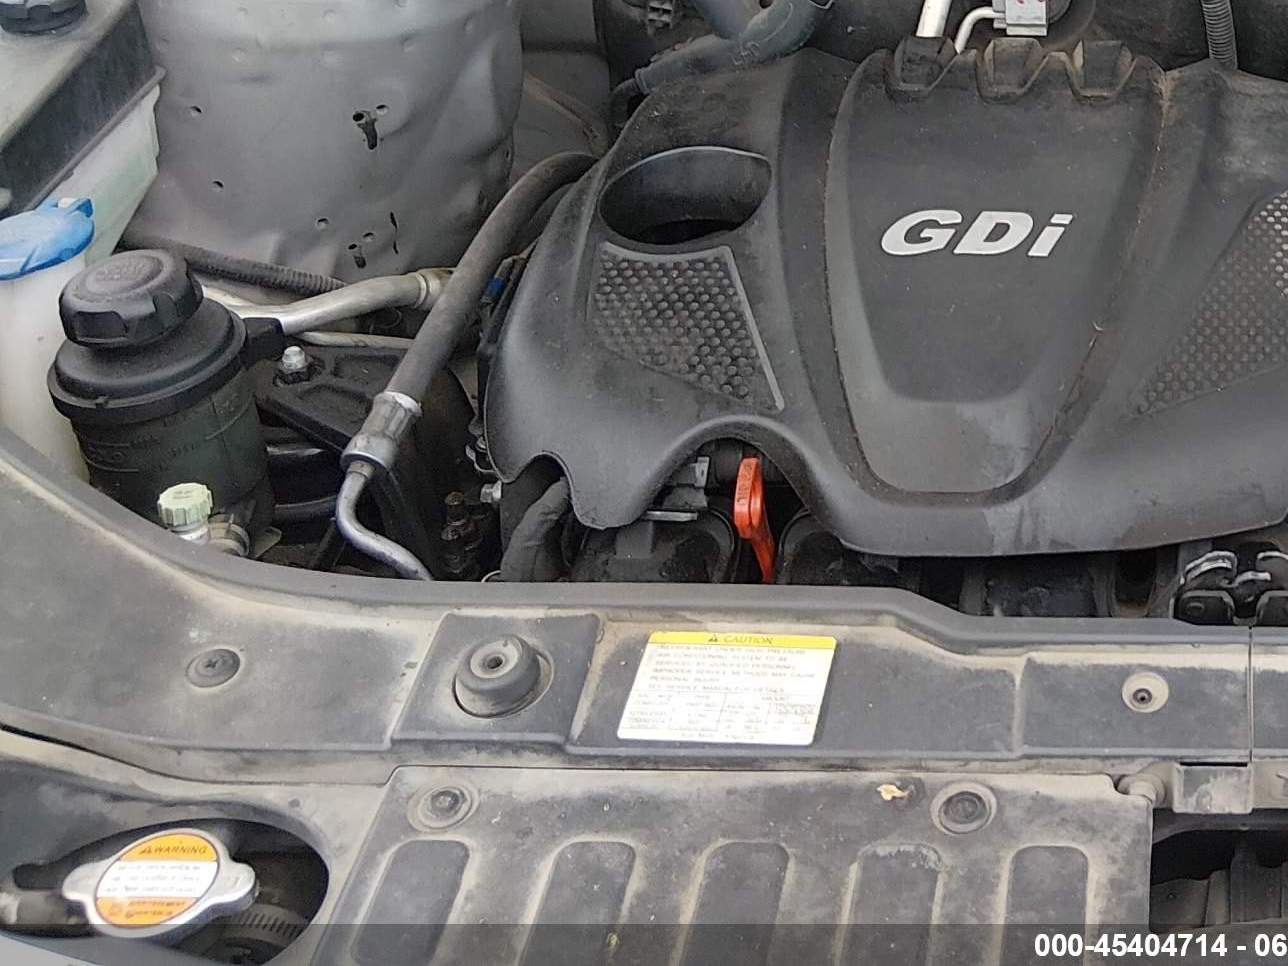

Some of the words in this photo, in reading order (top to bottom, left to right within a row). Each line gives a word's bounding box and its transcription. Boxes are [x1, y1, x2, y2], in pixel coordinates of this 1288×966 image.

[880, 209, 1073, 257] GDi
[724, 634, 774, 645] CAUTION
[153, 845, 208, 855] WARNING
